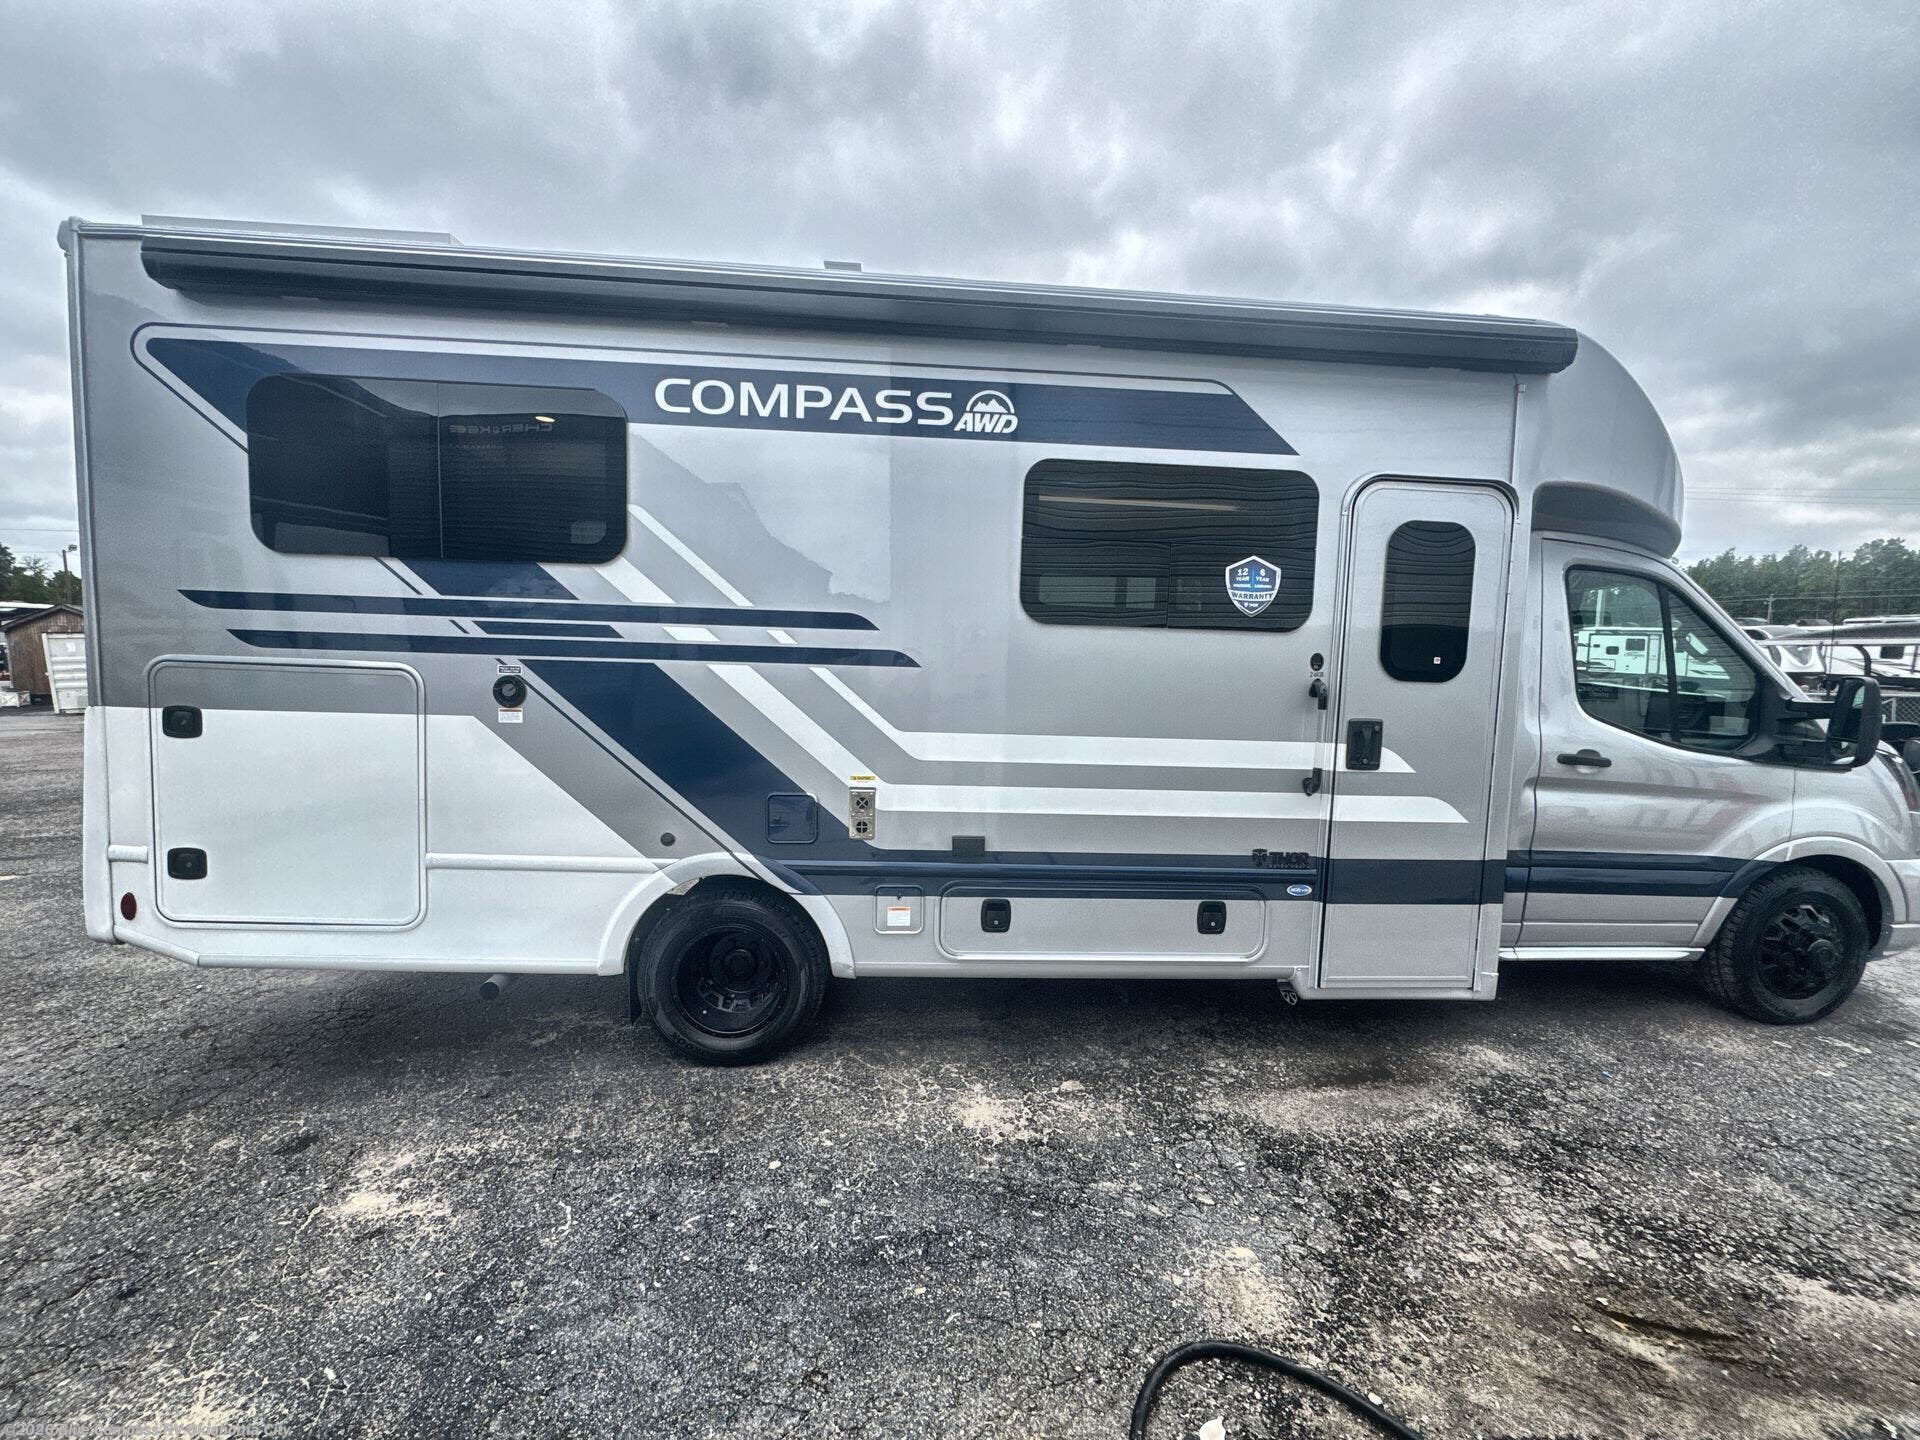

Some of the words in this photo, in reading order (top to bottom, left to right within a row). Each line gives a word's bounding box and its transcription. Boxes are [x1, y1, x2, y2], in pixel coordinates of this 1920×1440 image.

[654, 378, 954, 426] COMPASS
[953, 411, 1019, 434] AWD
[1237, 567, 1249, 576] 12
[1259, 568, 1266, 577] 6
[1231, 592, 1273, 600] WARRANTY
[1269, 851, 1309, 865] THOR
